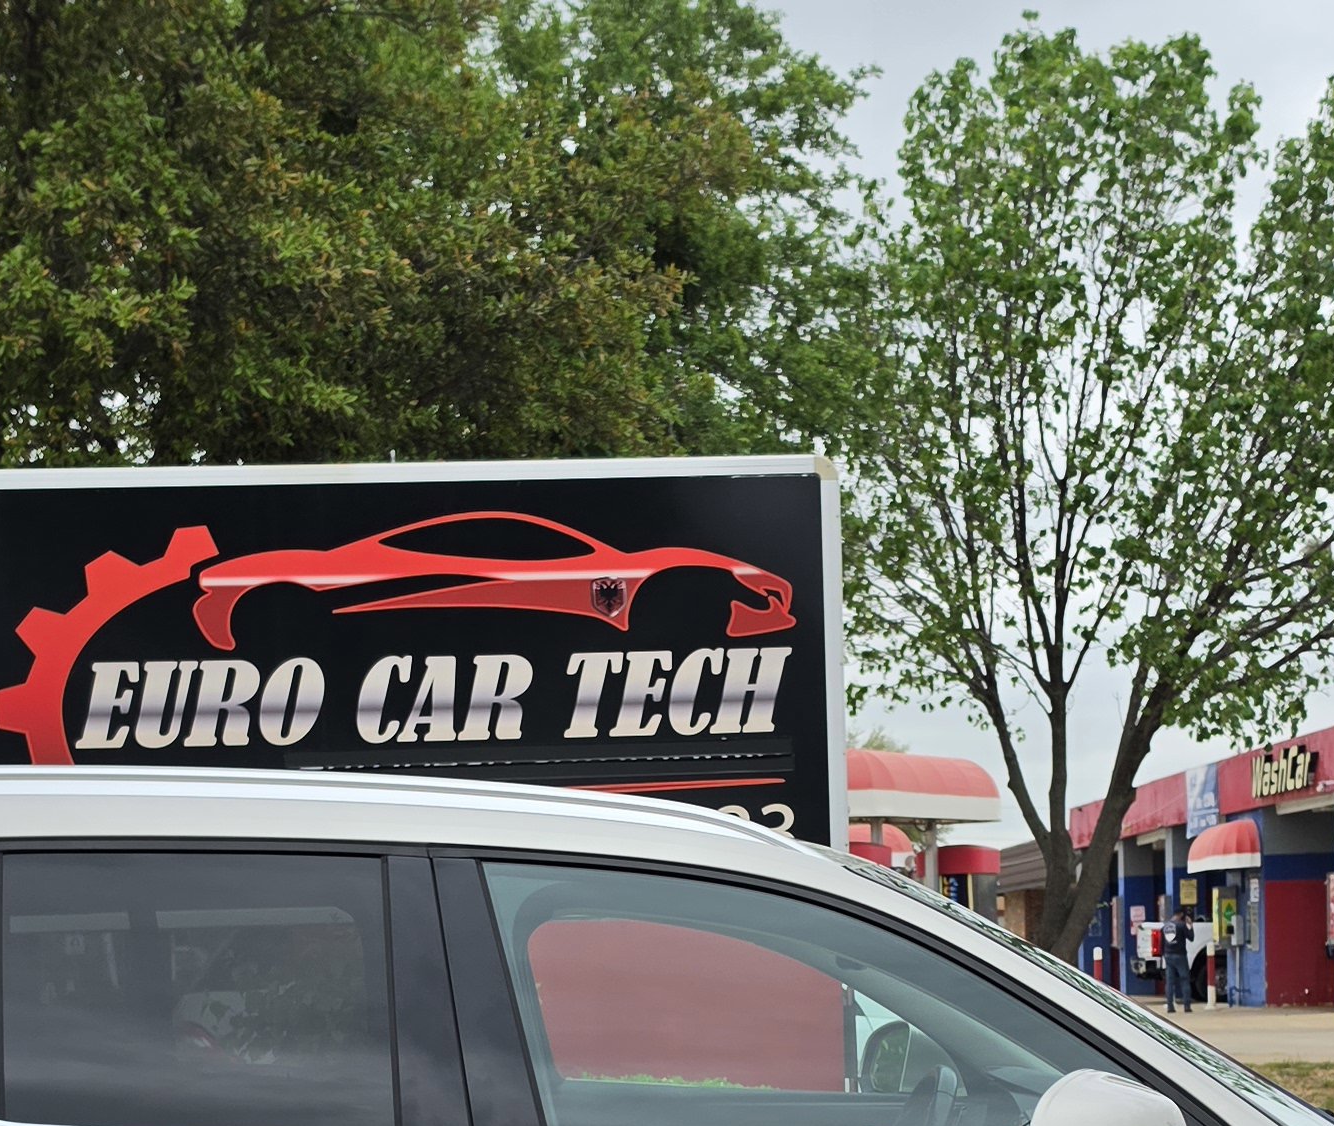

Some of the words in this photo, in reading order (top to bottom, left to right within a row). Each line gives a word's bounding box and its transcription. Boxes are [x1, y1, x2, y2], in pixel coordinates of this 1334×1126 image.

[75, 657, 325, 749] EURO
[356, 655, 533, 744] CAR
[564, 647, 792, 738] TECH
[1252, 745, 1311, 798] WashCar
